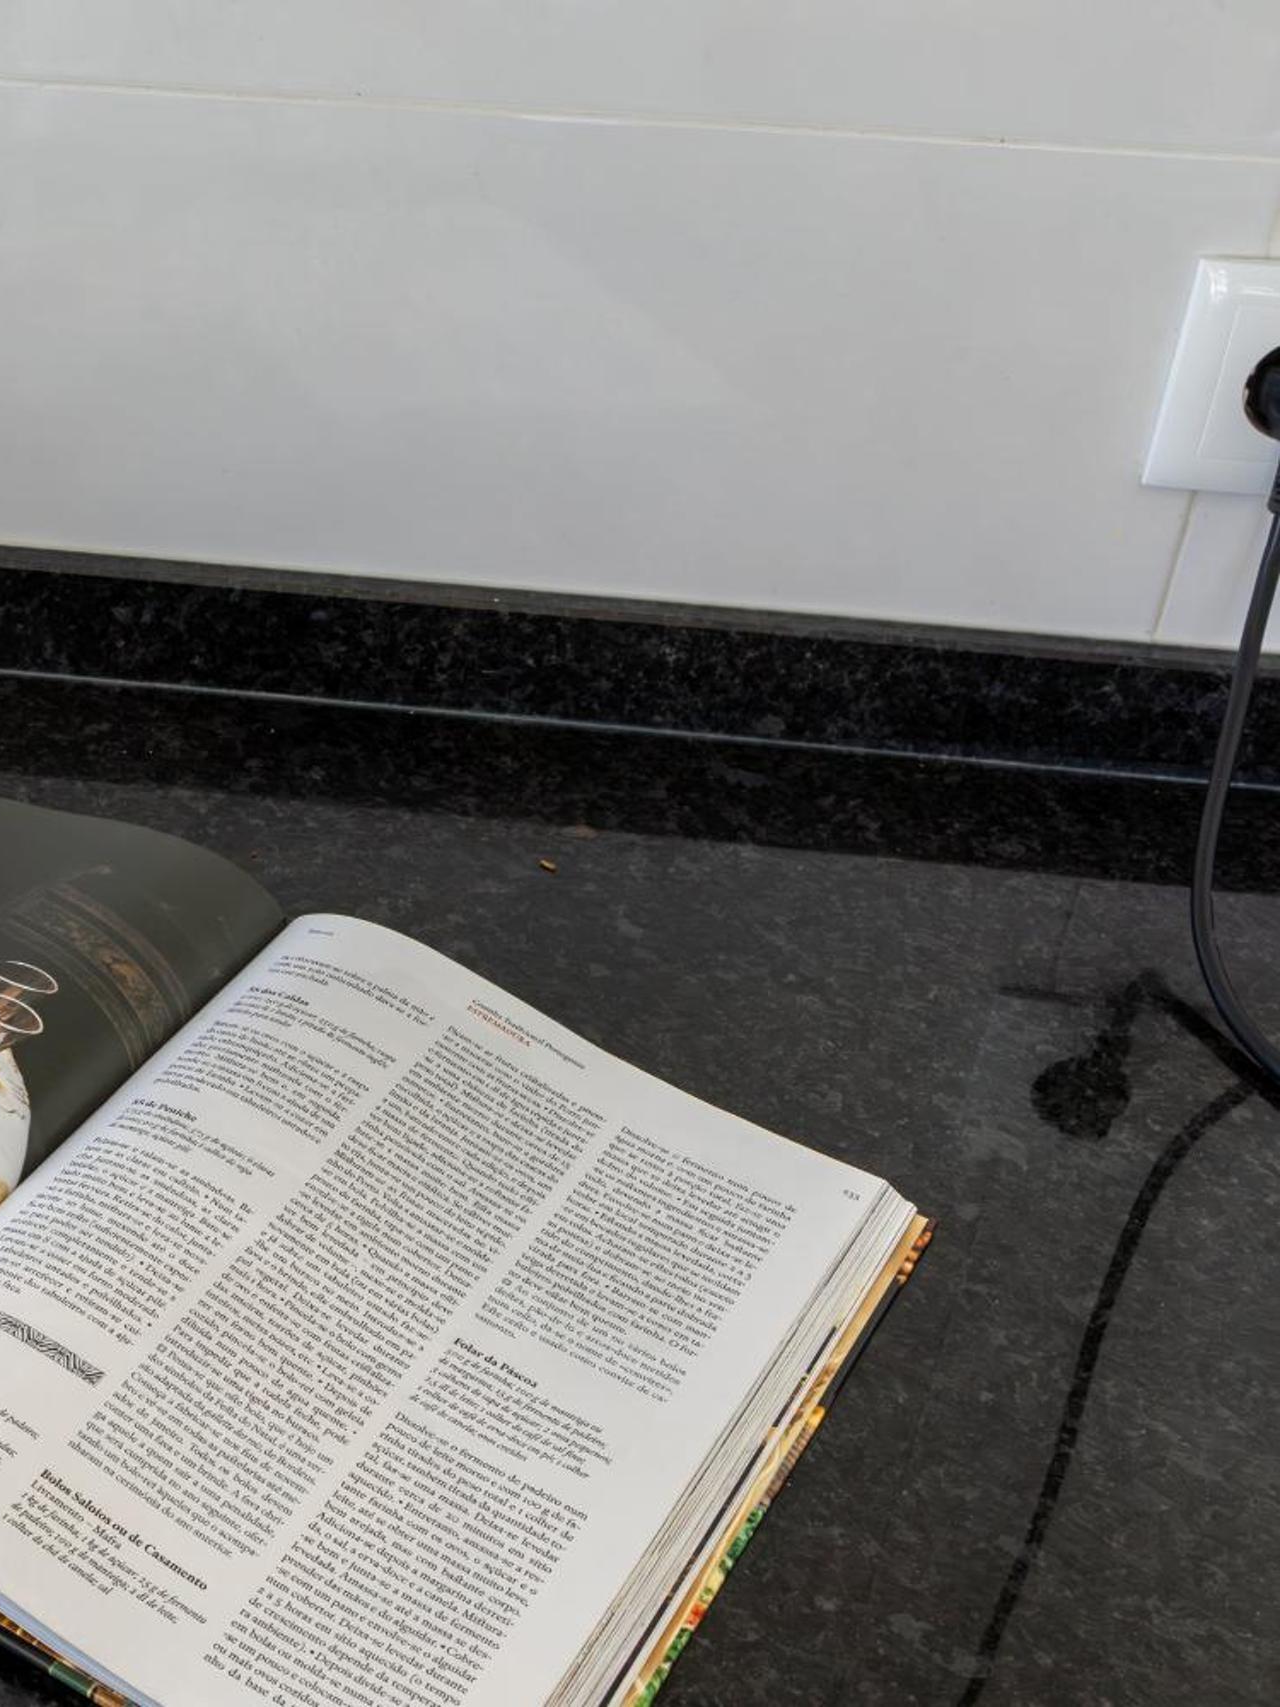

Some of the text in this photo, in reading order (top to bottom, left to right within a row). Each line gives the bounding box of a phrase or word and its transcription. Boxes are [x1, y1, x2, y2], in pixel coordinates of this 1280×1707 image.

[453, 1337, 537, 1388] Folar da Páscoa
[30, 1479, 123, 1550] Livramento Mafra
[40, 1468, 206, 1590] Bolos Saloios ou de Casamento
